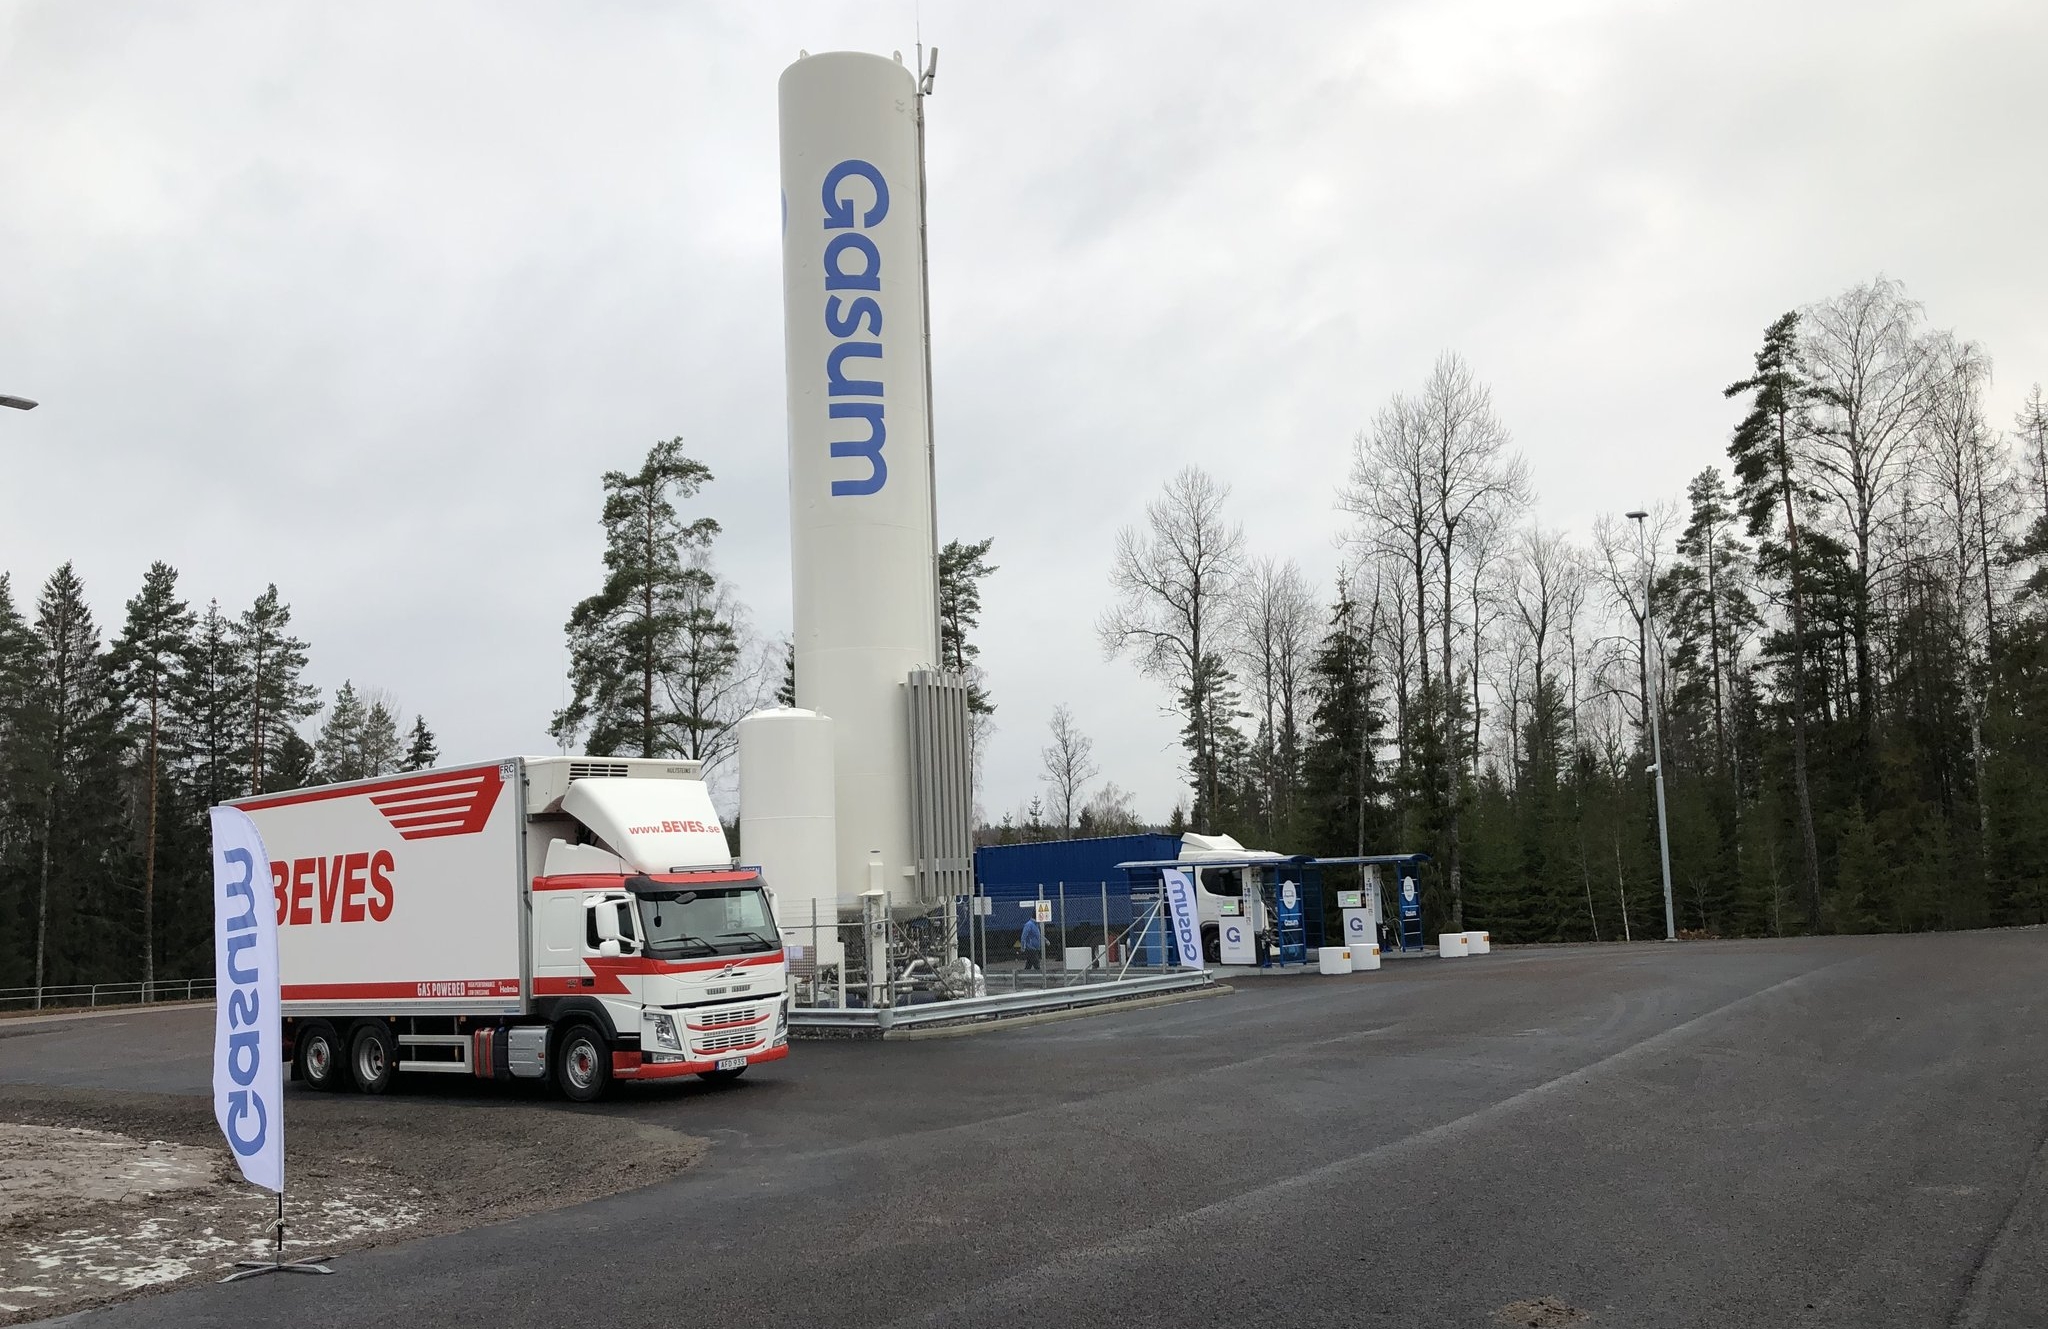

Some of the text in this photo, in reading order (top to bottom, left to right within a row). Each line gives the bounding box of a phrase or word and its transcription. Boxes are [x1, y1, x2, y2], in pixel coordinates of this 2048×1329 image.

[821, 159, 889, 497] Gasum
[500, 764, 514, 774] FRC
[629, 820, 720, 835] www.BEVES.se
[270, 849, 395, 926] BEVES
[1350, 917, 1363, 932] G
[1226, 927, 1240, 943] G
[417, 982, 465, 996] GAS POWERED
